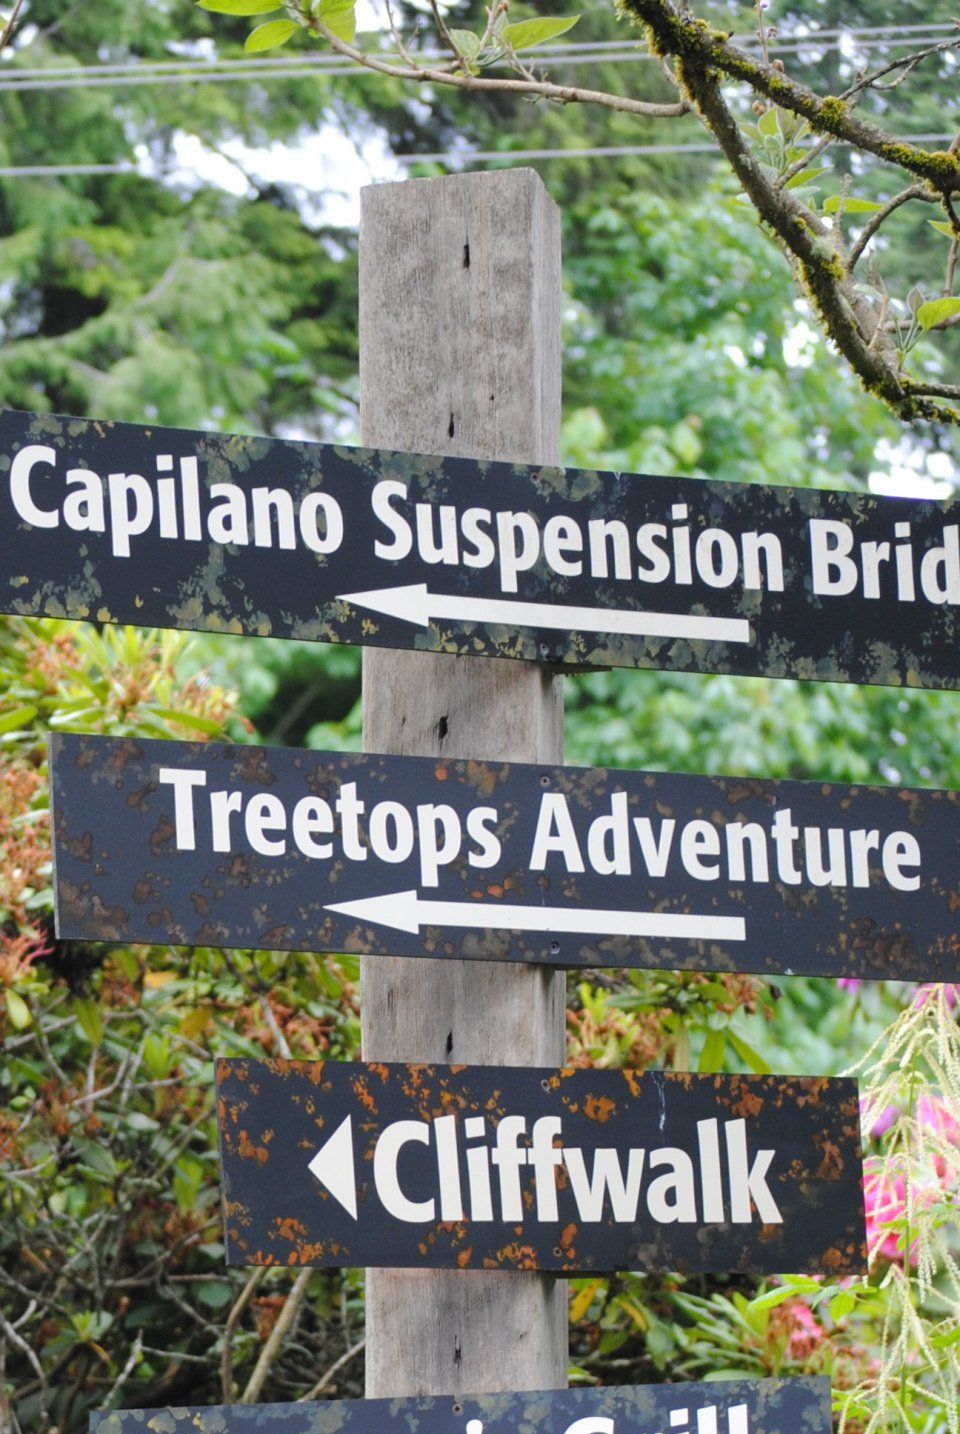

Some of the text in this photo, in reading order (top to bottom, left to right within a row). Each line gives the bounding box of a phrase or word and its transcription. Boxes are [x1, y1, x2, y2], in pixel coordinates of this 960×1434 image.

[8, 443, 960, 606] Capilano Suspension Brid
[158, 767, 921, 892] Treetops Adventure
[373, 1114, 784, 1224] Cliffwalk
